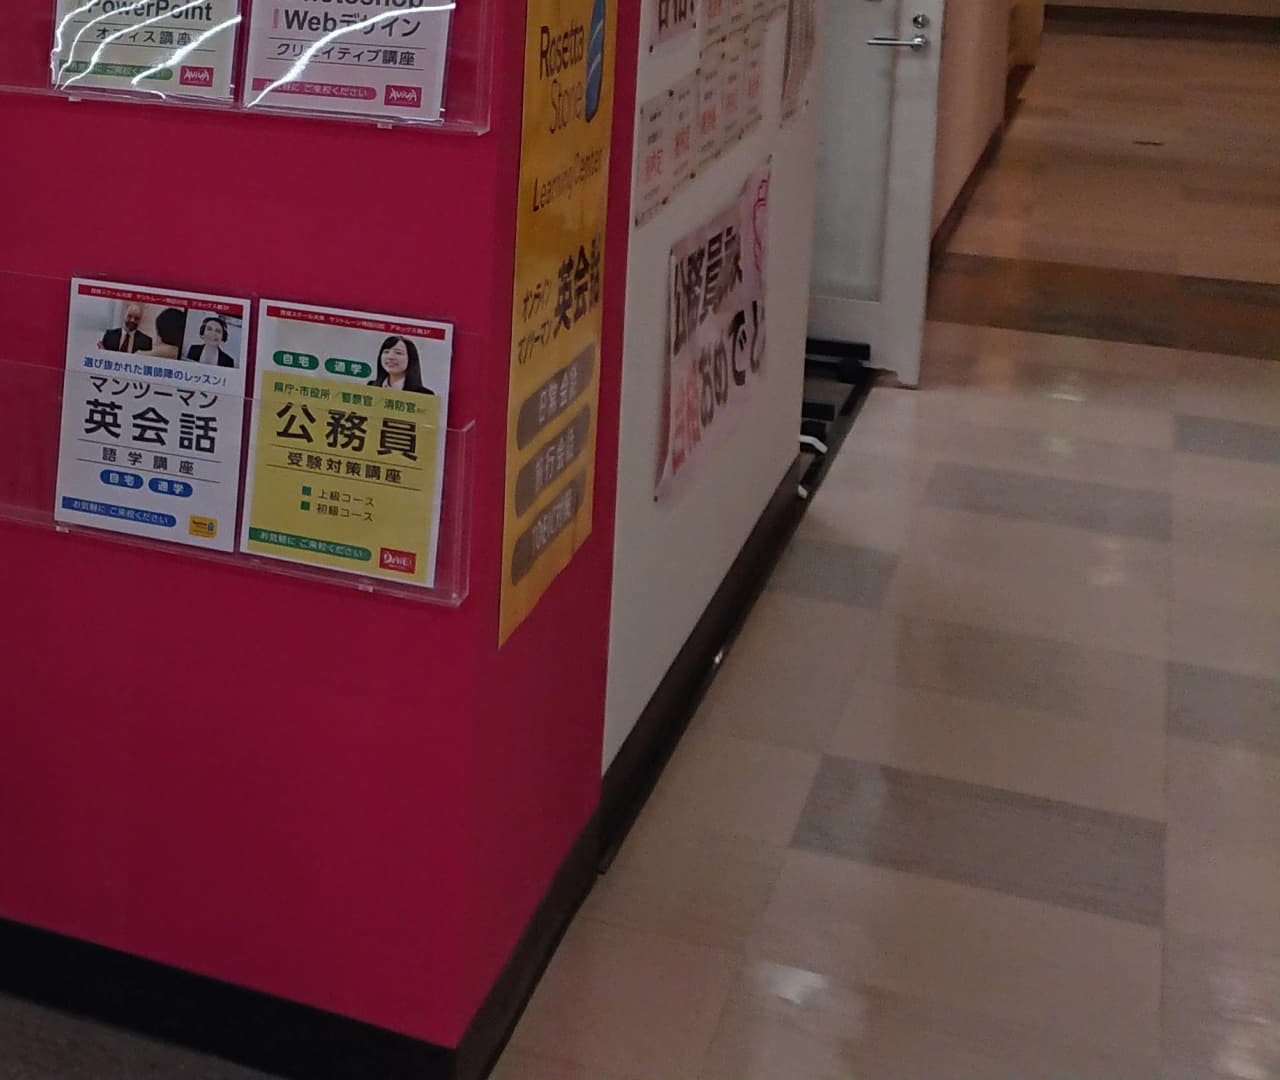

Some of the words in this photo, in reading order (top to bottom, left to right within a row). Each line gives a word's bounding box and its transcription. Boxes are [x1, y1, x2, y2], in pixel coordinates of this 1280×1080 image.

[96, 28, 191, 45] オフィス講座
[285, 9, 420, 37] Webデザイン
[277, 43, 415, 66] クリエイティブ講座
[539, 23, 585, 80] Rosetta
[550, 79, 584, 135] Stone
[283, 354, 310, 367] 自宅
[90, 375, 218, 409] マンツーマン
[84, 399, 218, 453] 英会話
[275, 401, 418, 462] 公務員
[102, 447, 194, 476] 語学講座
[287, 452, 402, 484] 受験対策講座
[110, 472, 135, 486] 自宅
[318, 487, 375, 507] 上級コース
[317, 503, 374, 522] 初級コース
